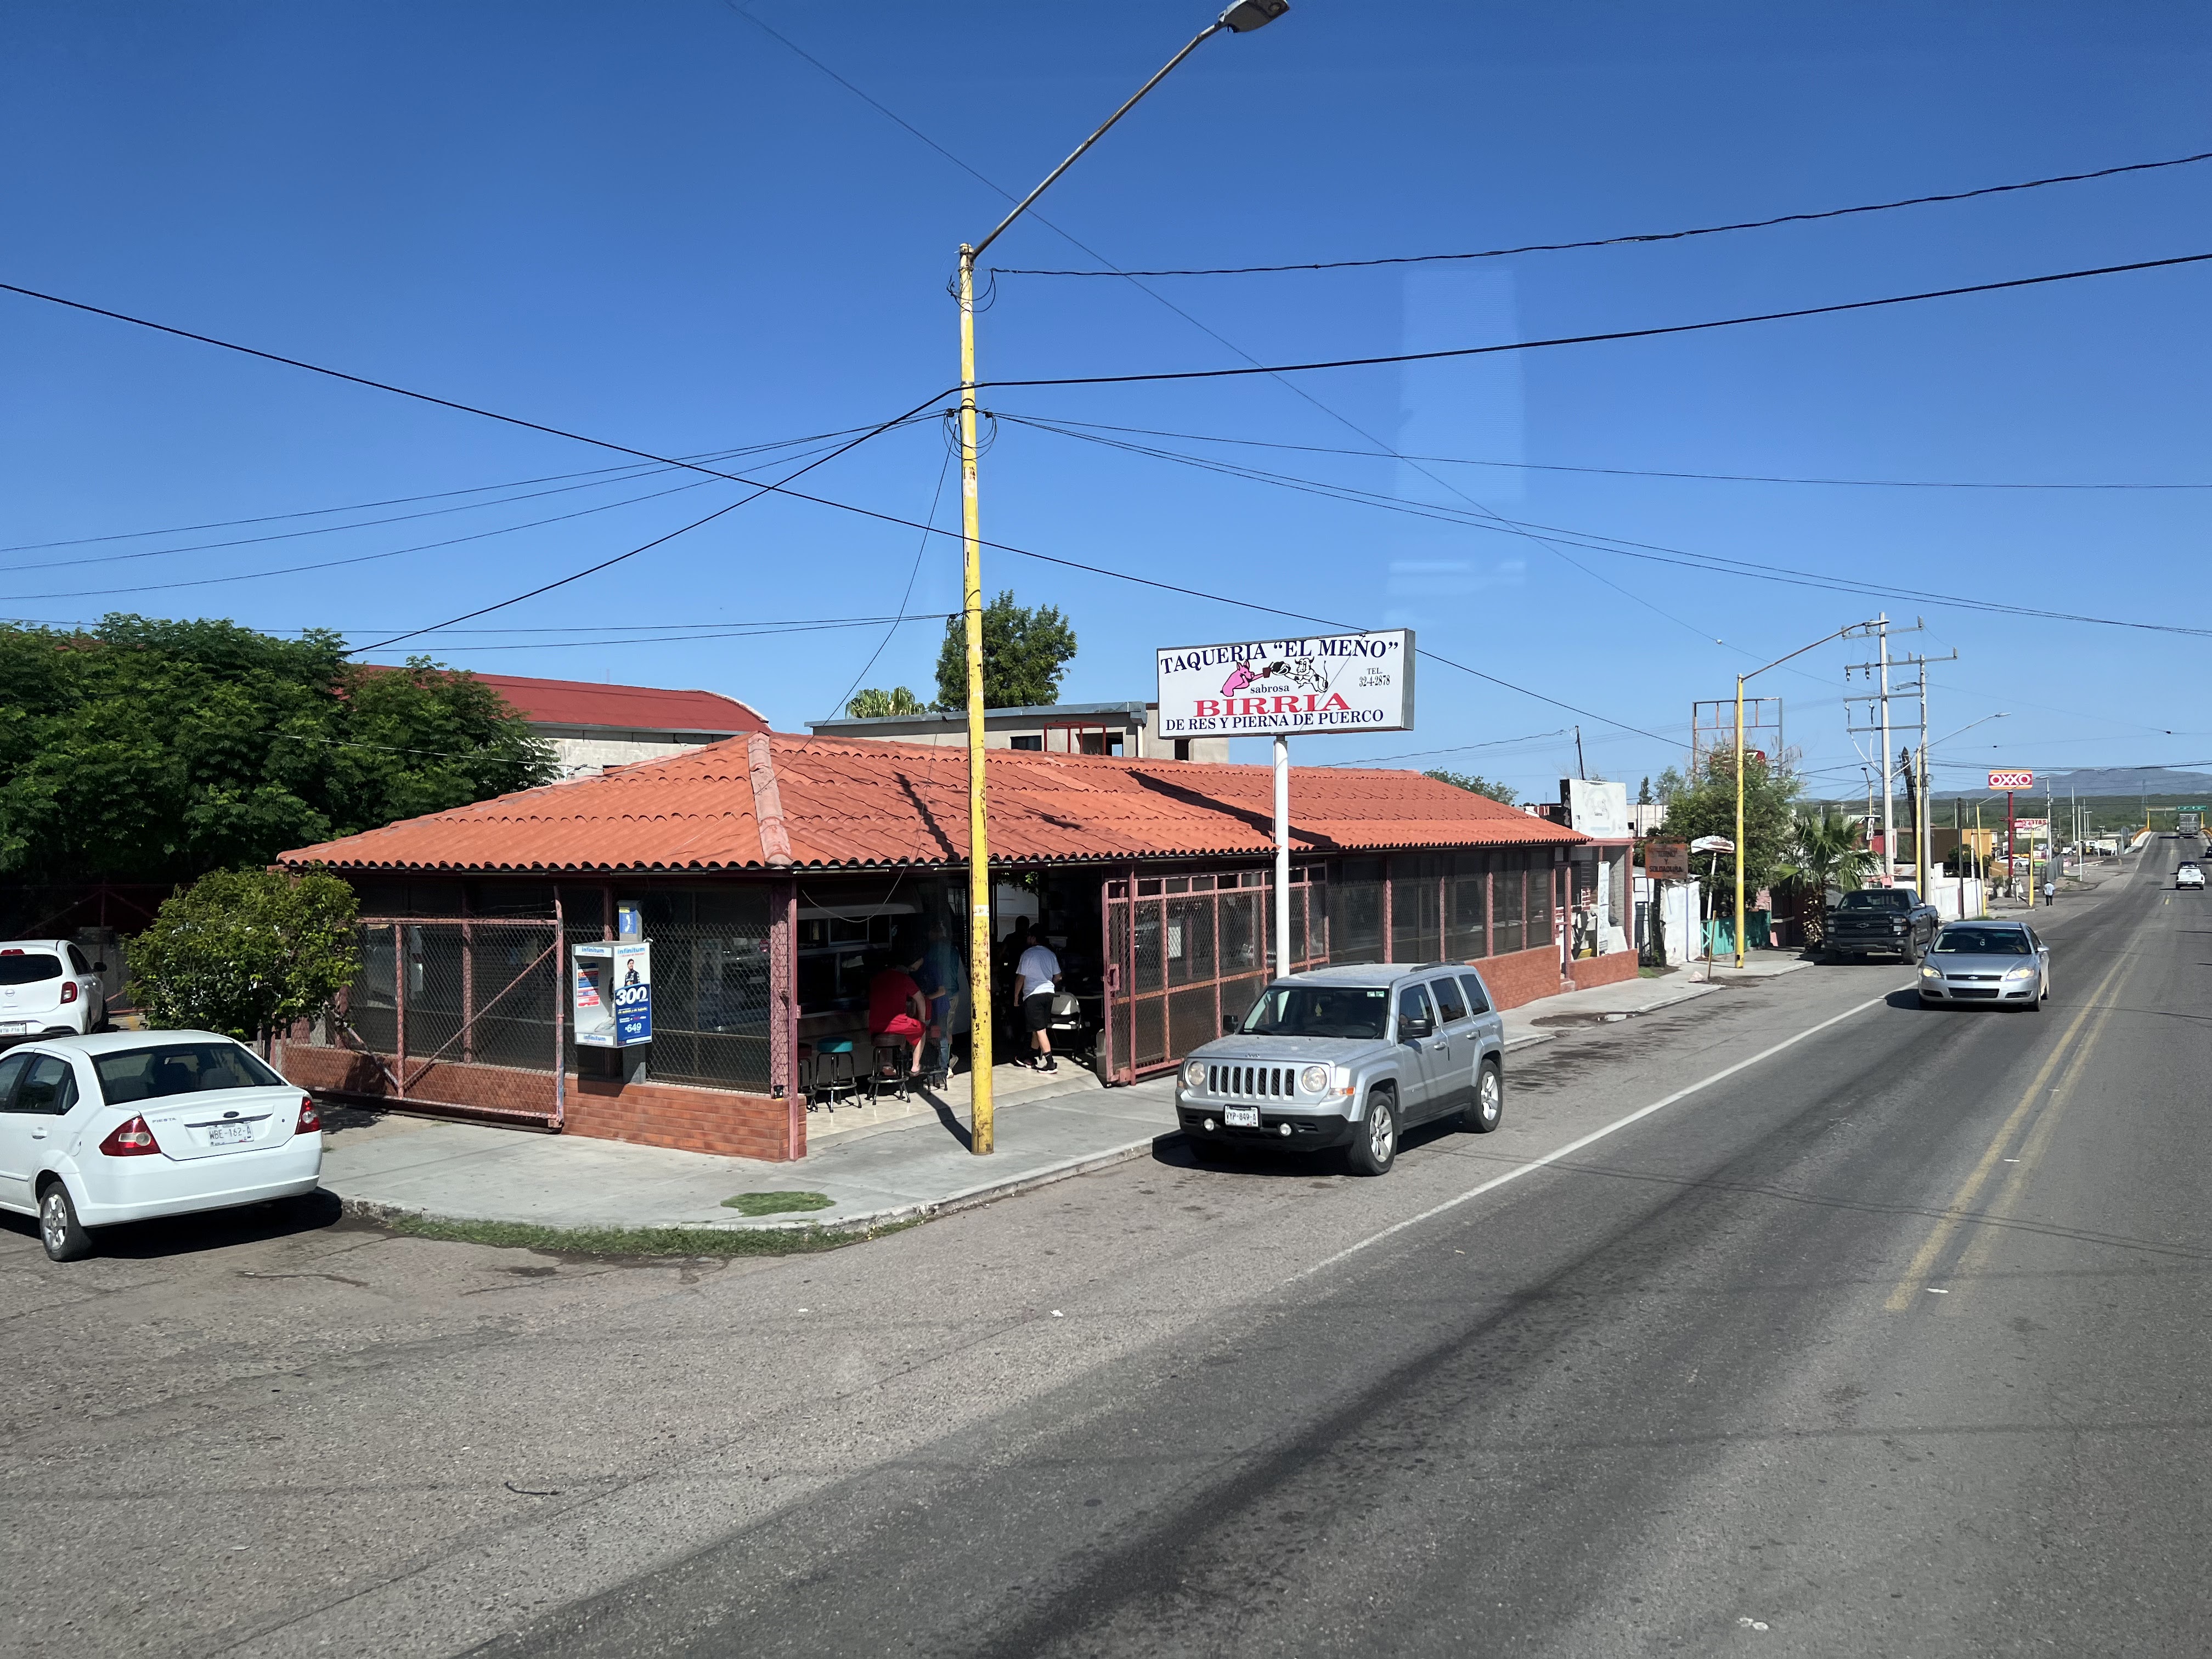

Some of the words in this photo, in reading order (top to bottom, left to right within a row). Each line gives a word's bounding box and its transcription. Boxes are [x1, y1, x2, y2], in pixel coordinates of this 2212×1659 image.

[1160, 642, 1267, 674] TAQUERIA
[1250, 684, 1290, 694] sabrosa
[1359, 674, 1390, 687] 32-4-2878
[1193, 692, 1352, 718] BIRRIA
[1165, 719, 1185, 731] DE
[1188, 718, 1216, 730] RES
[1219, 717, 1229, 729] Y
[1232, 714, 1289, 729] PIERNA
[1293, 713, 1314, 726] DE
[1317, 709, 1384, 725] PUERCO
[1990, 774, 2031, 786] OXXO
[616, 986, 647, 1006] 300
